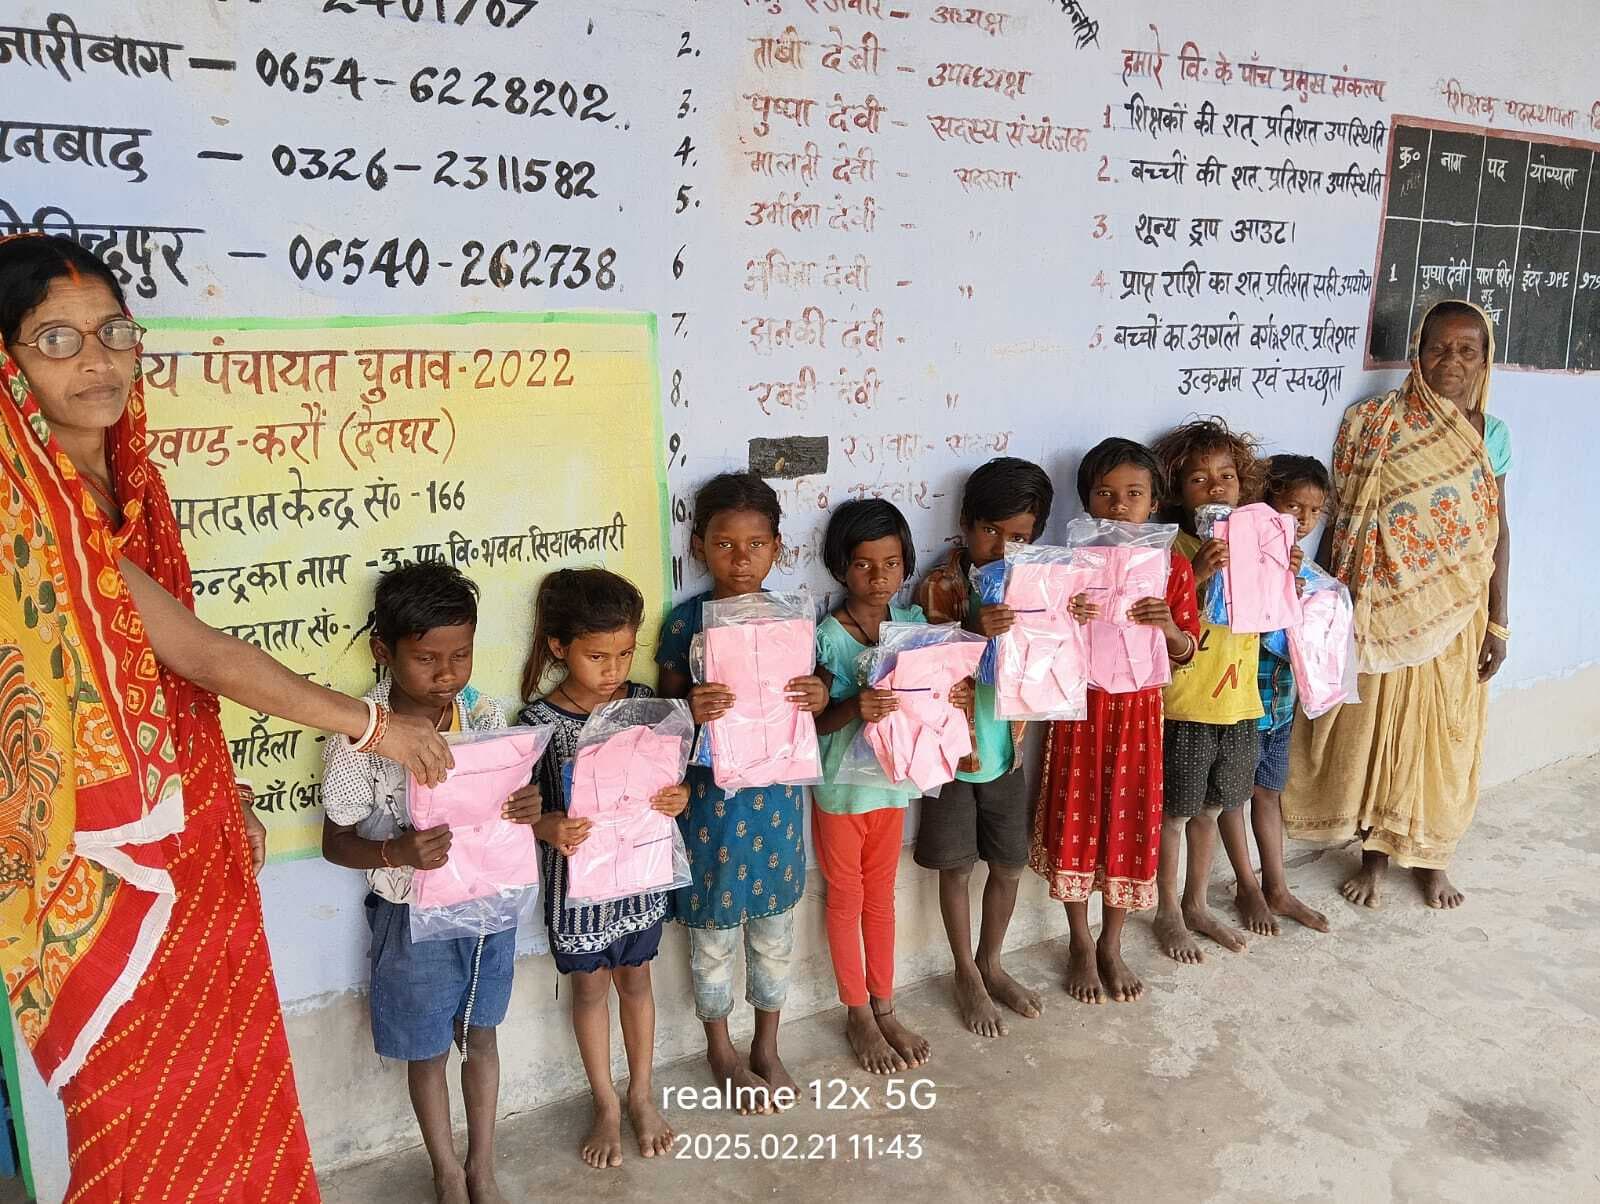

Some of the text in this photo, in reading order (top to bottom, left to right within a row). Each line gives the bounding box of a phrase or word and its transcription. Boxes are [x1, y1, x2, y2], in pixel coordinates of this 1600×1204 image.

[1121, 24, 1170, 90] हमारे
[1214, 52, 1232, 86] के
[1280, 67, 1328, 103] प्रमुख
[1329, 64, 1387, 101] संकल्प
[826, 93, 888, 133] देवी
[1124, 92, 1188, 140] शिक्षकों
[1193, 100, 1220, 138] की
[1261, 104, 1324, 147] प्रतिशत
[1324, 116, 1388, 154] उपस्थिति
[1129, 149, 1189, 186] बच्चों
[1196, 155, 1228, 187] की
[1264, 158, 1325, 194] प्रतिशत
[1326, 162, 1387, 201] उपस्थिति
[1440, 152, 1468, 175] नाम
[1487, 158, 1509, 182] पद
[1530, 154, 1578, 191] योग्यता
[1135, 213, 1180, 248] शून्य
[670, 244, 687, 281] 6
[1162, 260, 1206, 298] राशि
[1208, 270, 1233, 295] का
[1388, 264, 1398, 283] 1
[1448, 257, 1473, 291] देवी
[1113, 312, 1163, 350] बच्चों
[1163, 324, 1188, 350] का
[1188, 311, 1244, 352] अगले
[1309, 318, 1360, 354] प्रतिशत
[192, 337, 348, 396] पंचायत
[1252, 358, 1282, 399] एवं
[338, 404, 456, 471] (देवघर)
[297, 554, 352, 588] नाम
[229, 723, 303, 770] महिला
